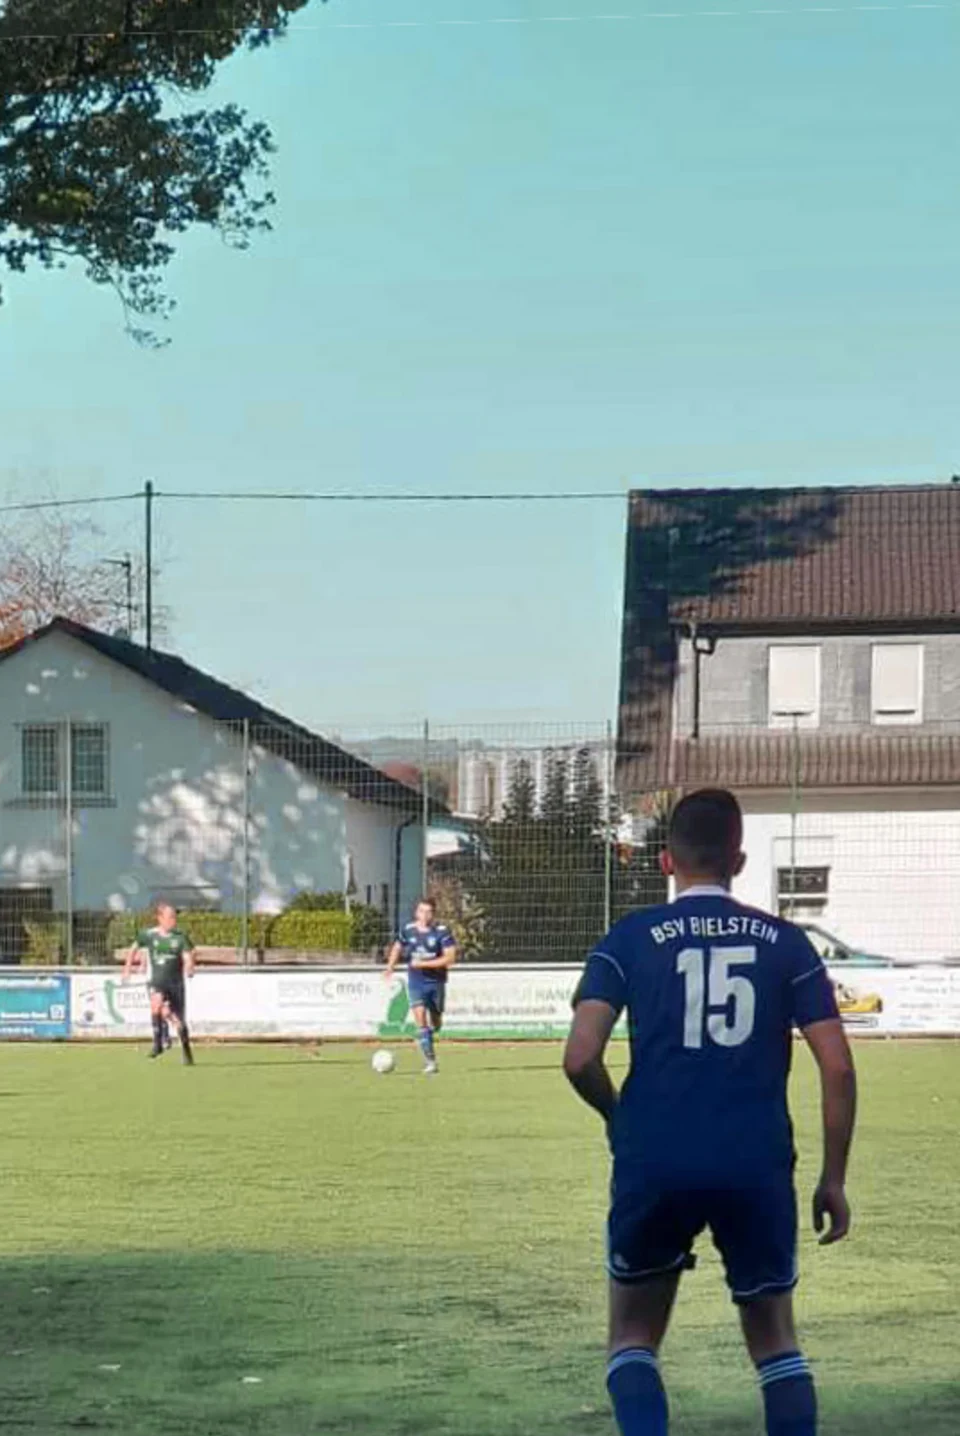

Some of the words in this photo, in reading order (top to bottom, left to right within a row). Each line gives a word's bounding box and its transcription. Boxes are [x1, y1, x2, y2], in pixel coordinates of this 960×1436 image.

[650, 917, 685, 944] BSV
[690, 916, 780, 944] BIELSTEIN
[676, 945, 757, 1049] 15
